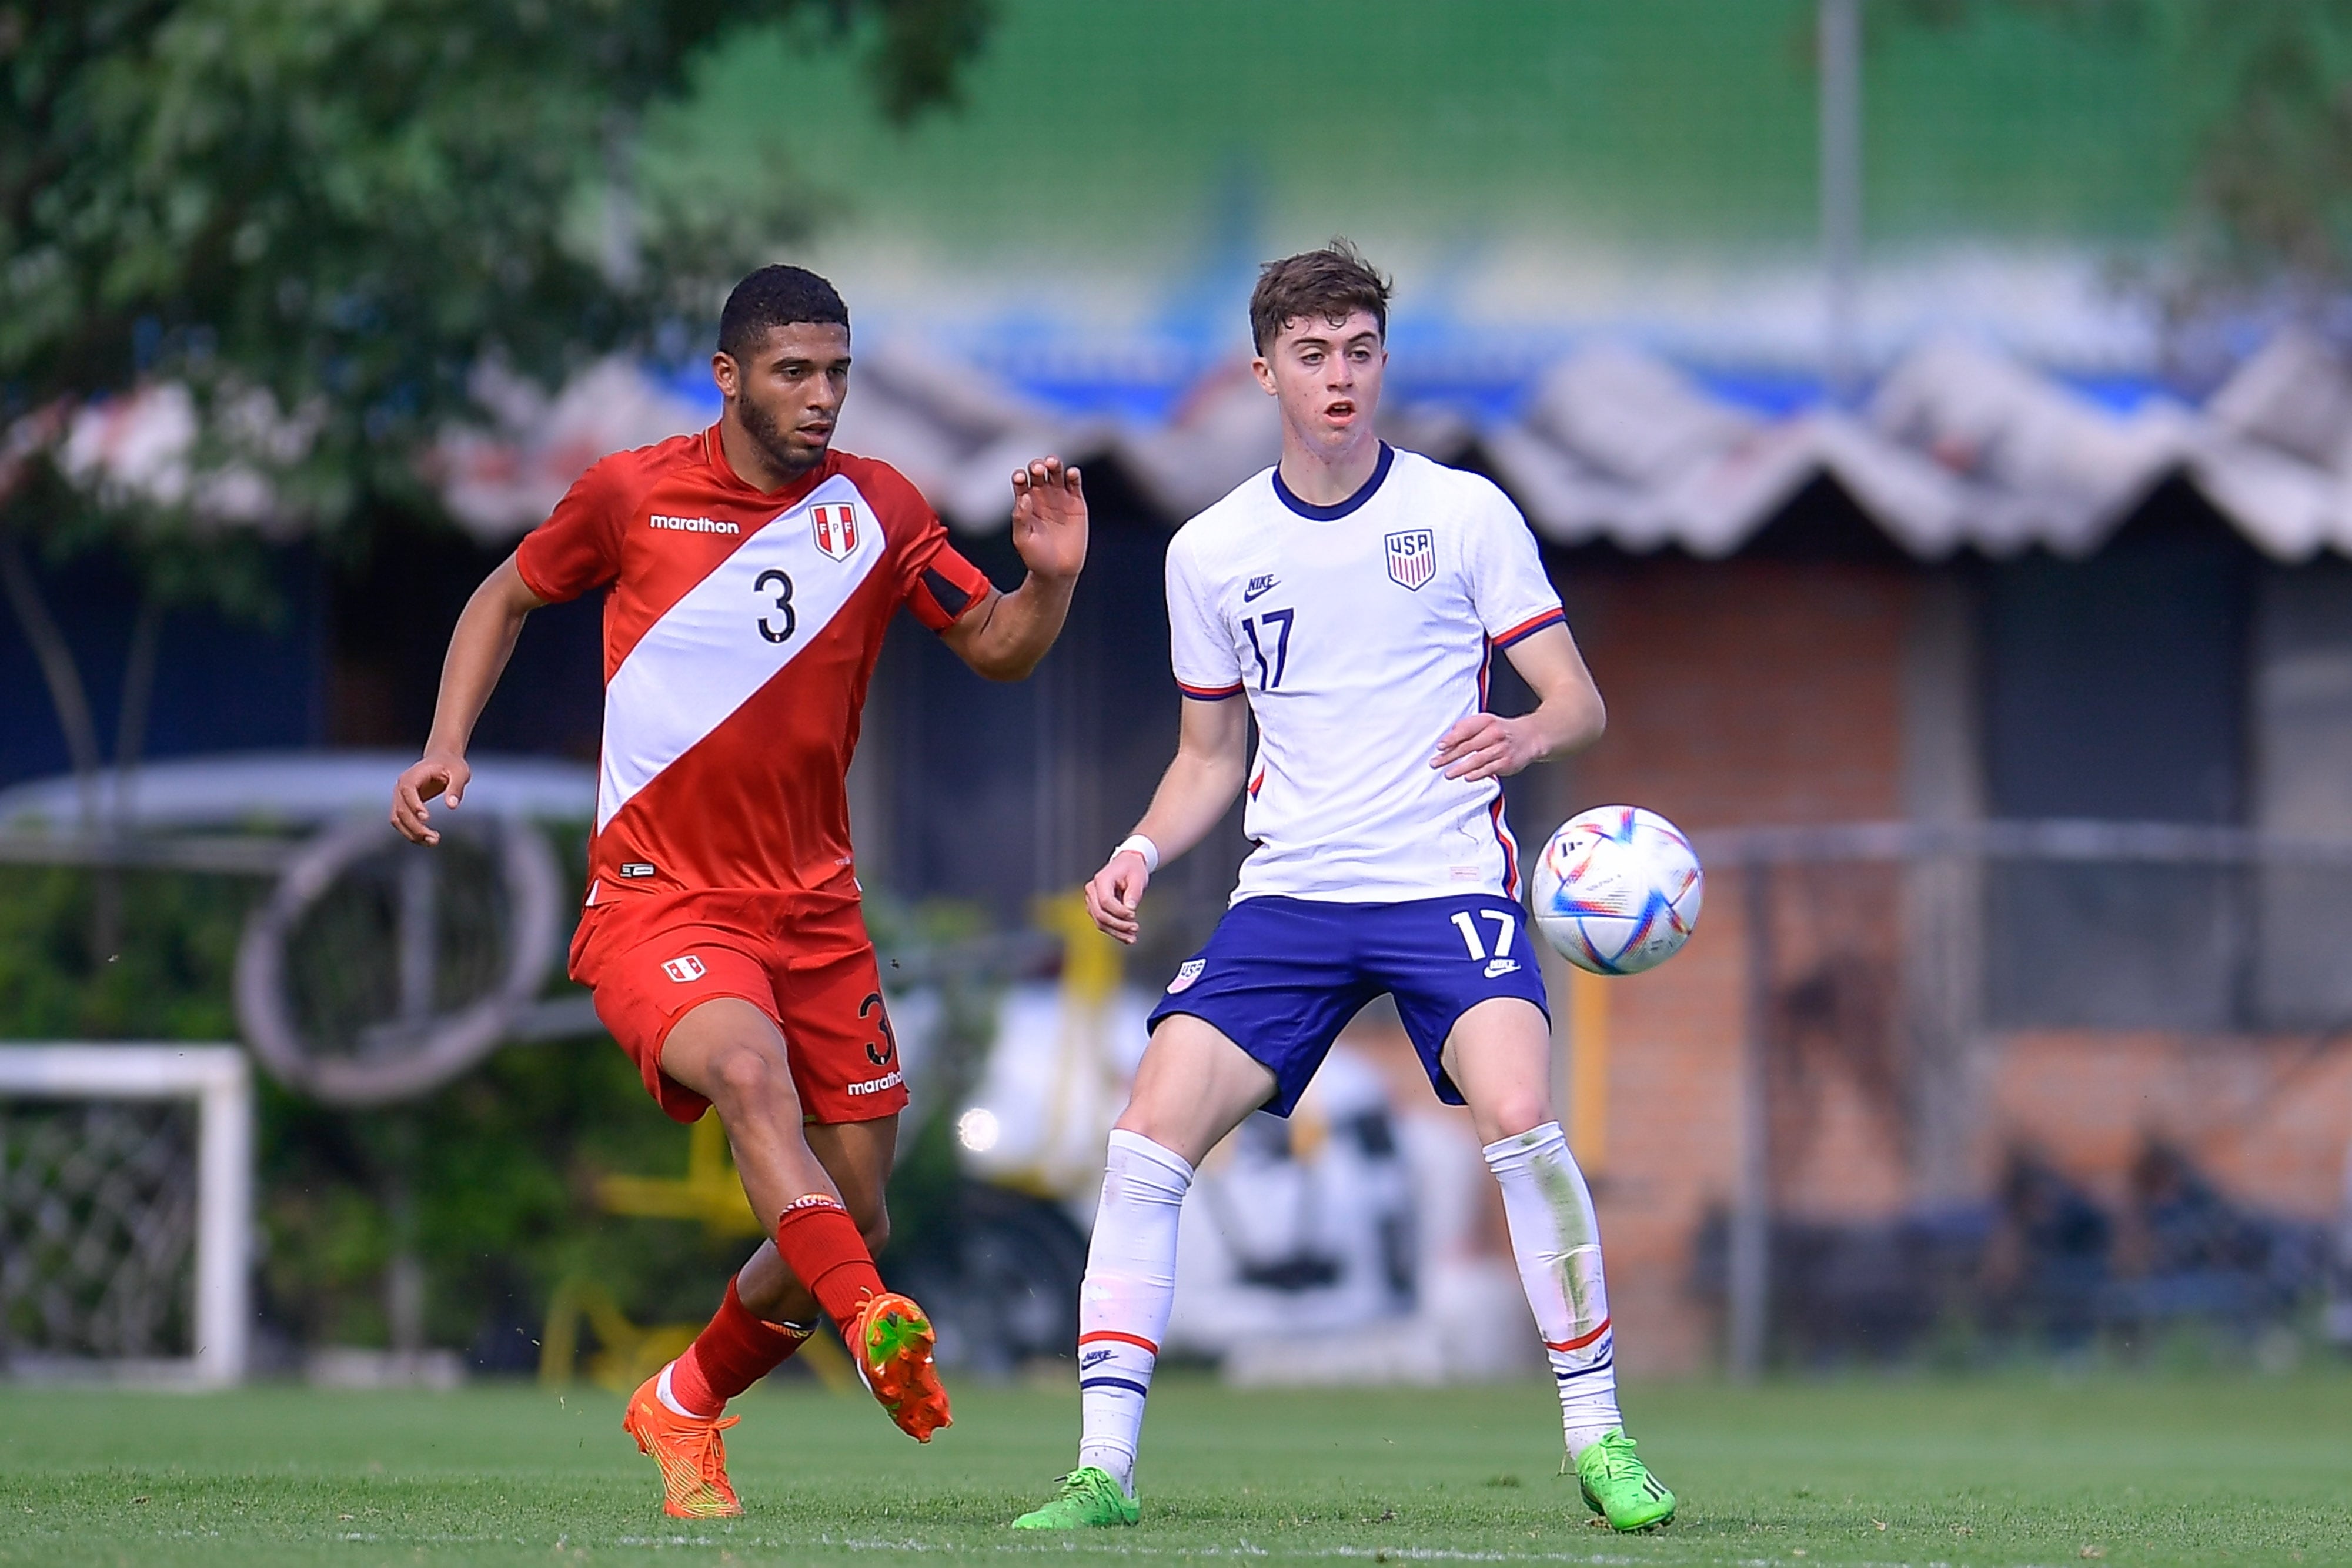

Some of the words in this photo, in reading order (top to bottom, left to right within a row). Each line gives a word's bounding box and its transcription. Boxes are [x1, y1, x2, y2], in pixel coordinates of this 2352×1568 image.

[650, 514, 740, 534] marathon
[1390, 534, 1428, 556] USA
[753, 568, 796, 644] 3
[1248, 574, 1274, 591] NIKE
[1241, 607, 1294, 691] 17
[1450, 908, 1516, 961] 17
[858, 992, 893, 1066] 3
